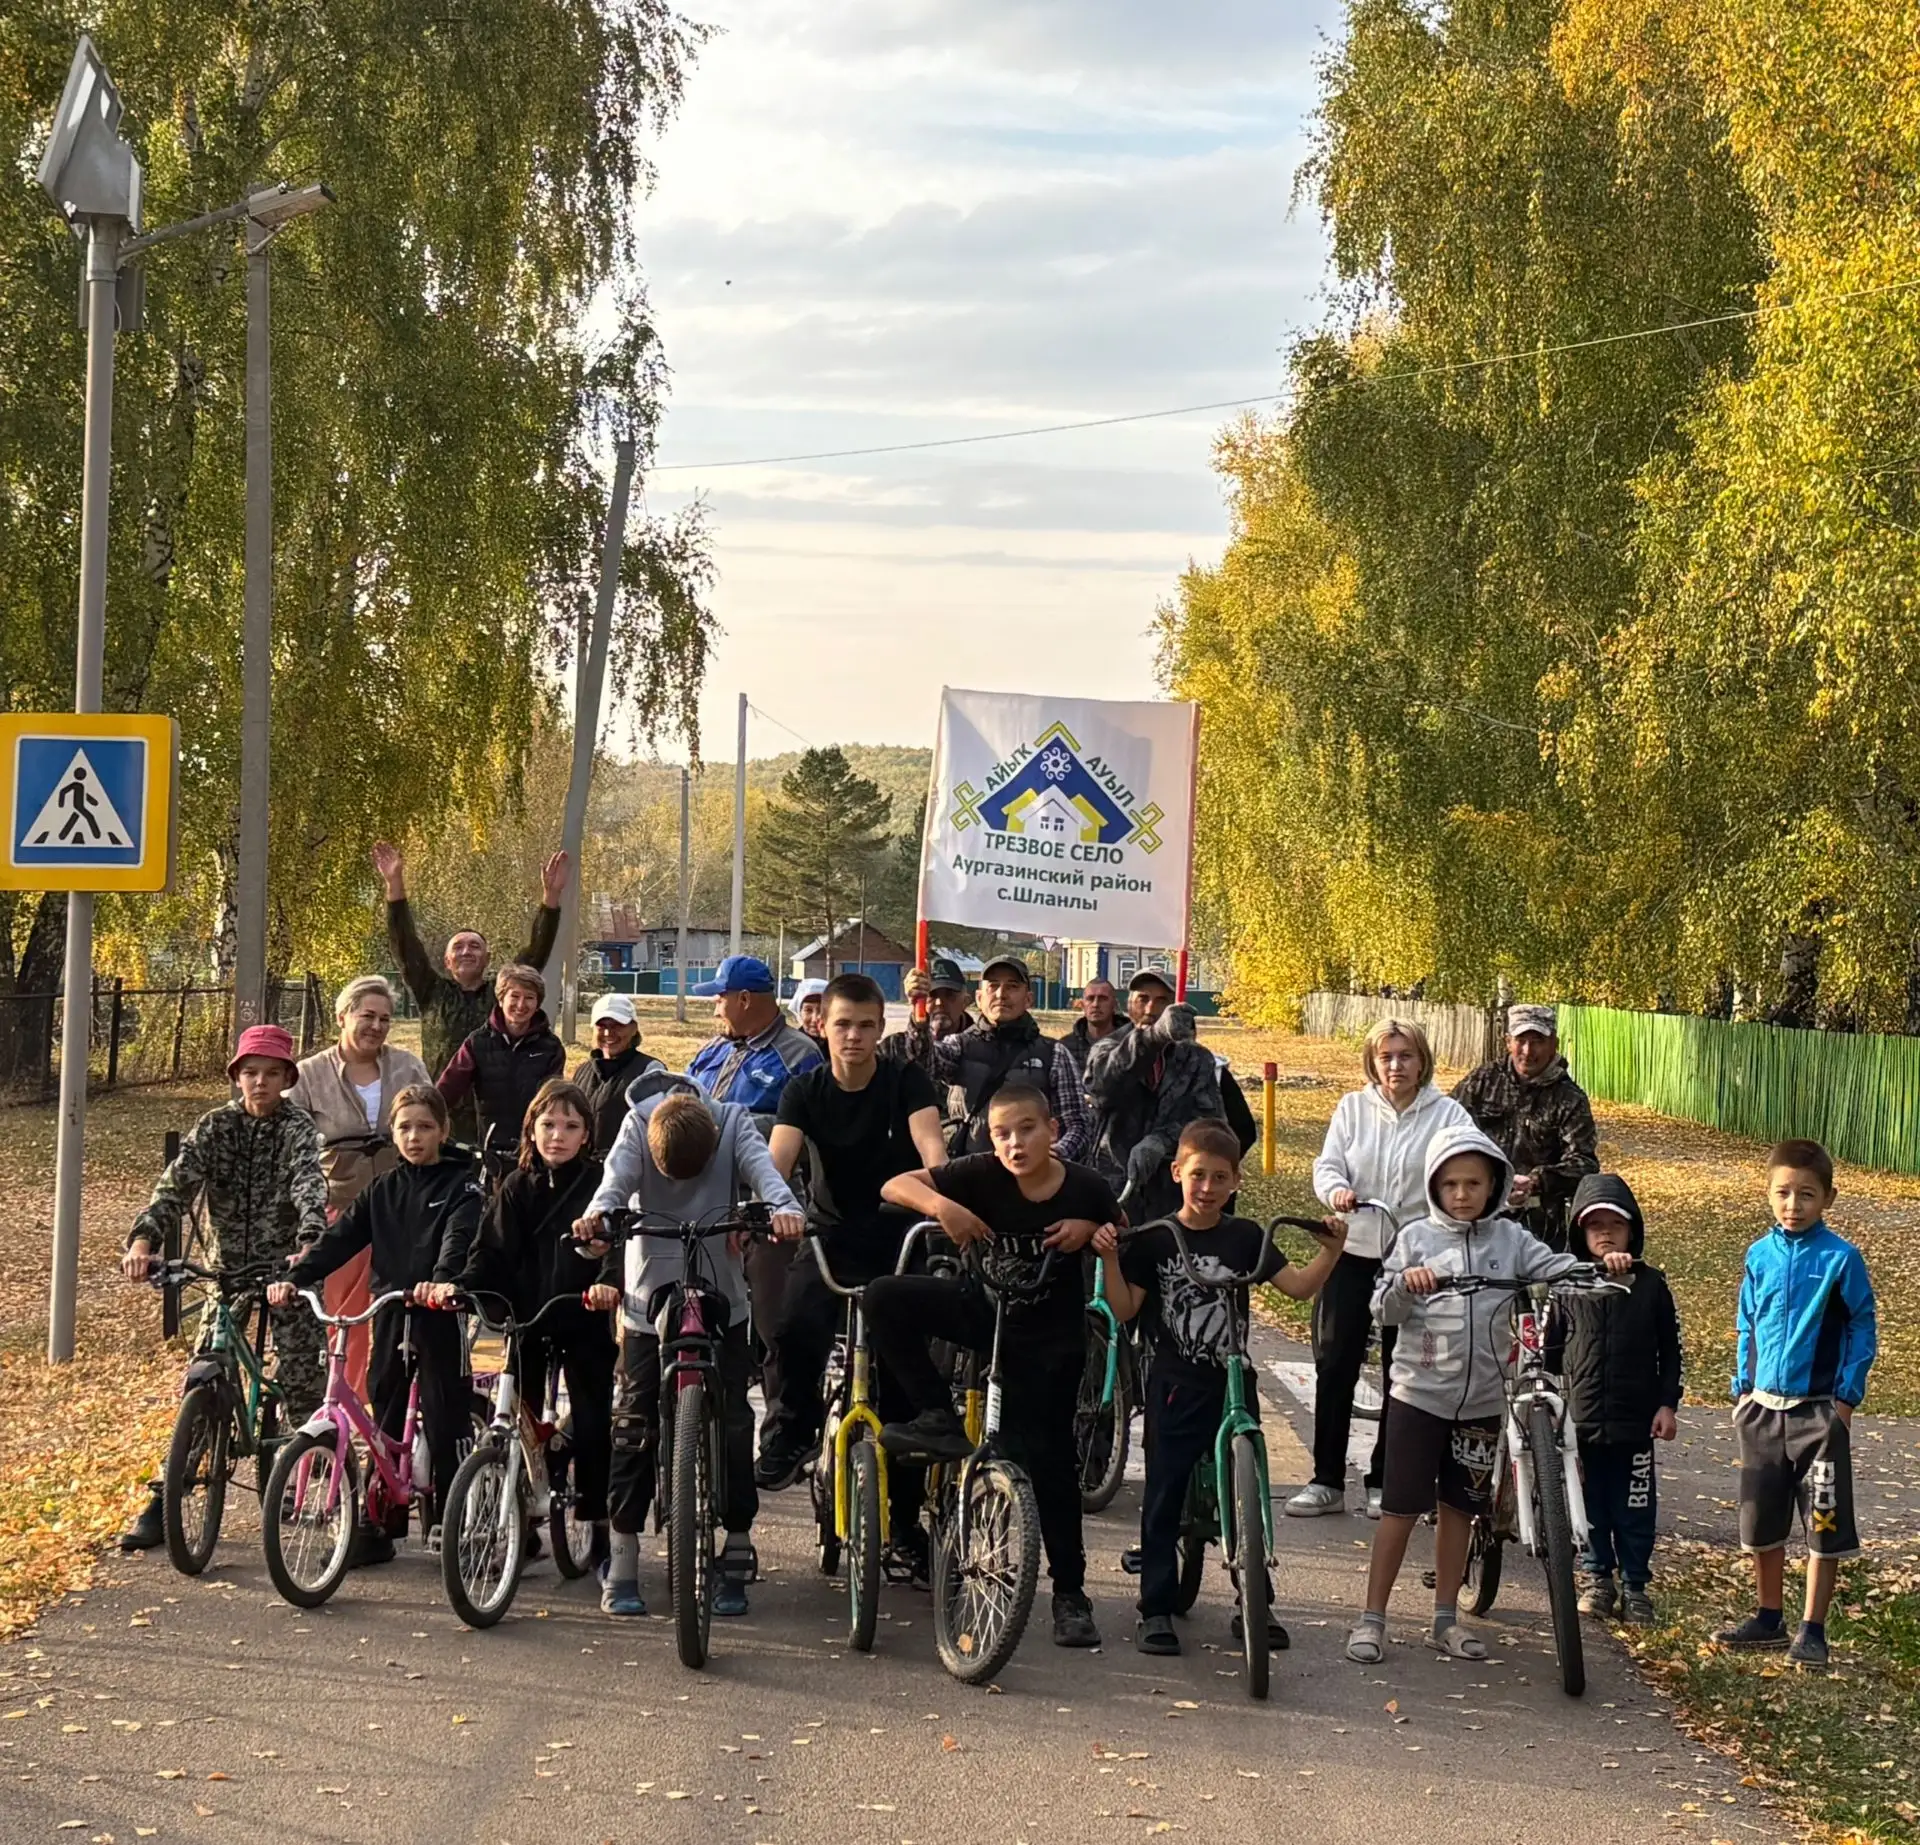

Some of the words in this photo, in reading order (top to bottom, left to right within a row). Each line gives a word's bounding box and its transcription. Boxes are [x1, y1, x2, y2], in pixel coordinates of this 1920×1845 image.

[1085, 756, 1135, 808] АУЫЛ
[984, 832, 1065, 859] ТРЕЗВОЕ
[1070, 844, 1124, 864] СЕЛО
[952, 854, 1084, 886] Аургазинский
[1090, 873, 1152, 892] район
[997, 886, 1098, 911] с.Шланлы
[1628, 1450, 1651, 1508] BEAR
